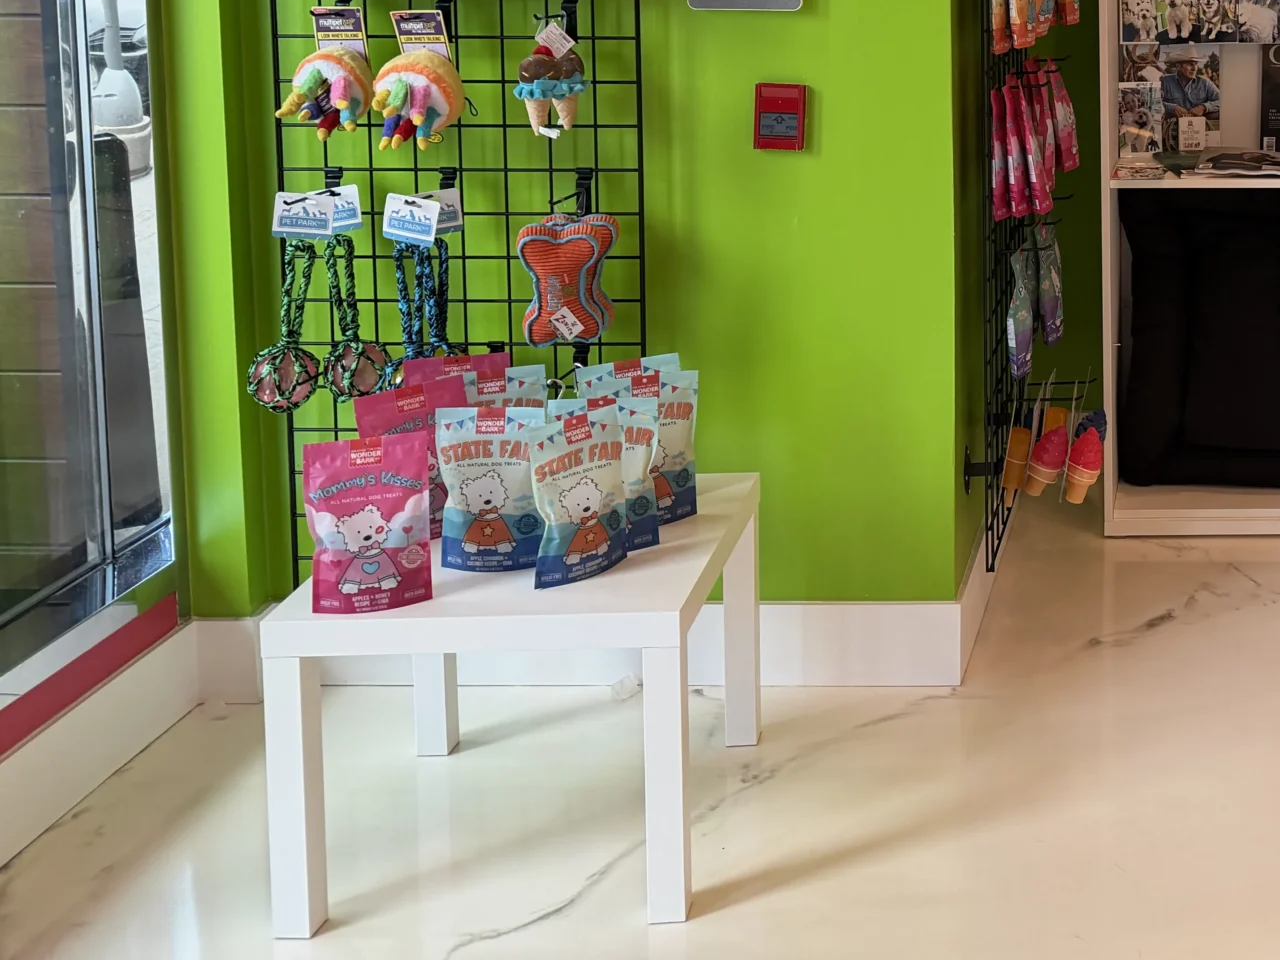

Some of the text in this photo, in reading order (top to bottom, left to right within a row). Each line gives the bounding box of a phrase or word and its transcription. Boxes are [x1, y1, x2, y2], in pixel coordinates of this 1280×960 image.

[334, 211, 348, 219] ARK
[390, 220, 422, 231] PET PARK
[615, 371, 642, 379] WONDER
[478, 381, 505, 389] WONDER
[632, 386, 659, 394] WONDER
[396, 396, 425, 407] WONDER
[403, 402, 420, 411] BARK
[476, 420, 505, 428] WONDER
[565, 425, 590, 438] WONDER
[625, 426, 654, 447] AIR
[571, 433, 587, 441] BARK
[351, 450, 382, 460] WONDER
[440, 440, 494, 465] STATE
[534, 441, 623, 483] STATE FAIR
[562, 470, 582, 480] NATURAL
[594, 462, 612, 471] TREATS
[308, 471, 424, 504] Mommy's Kisses
